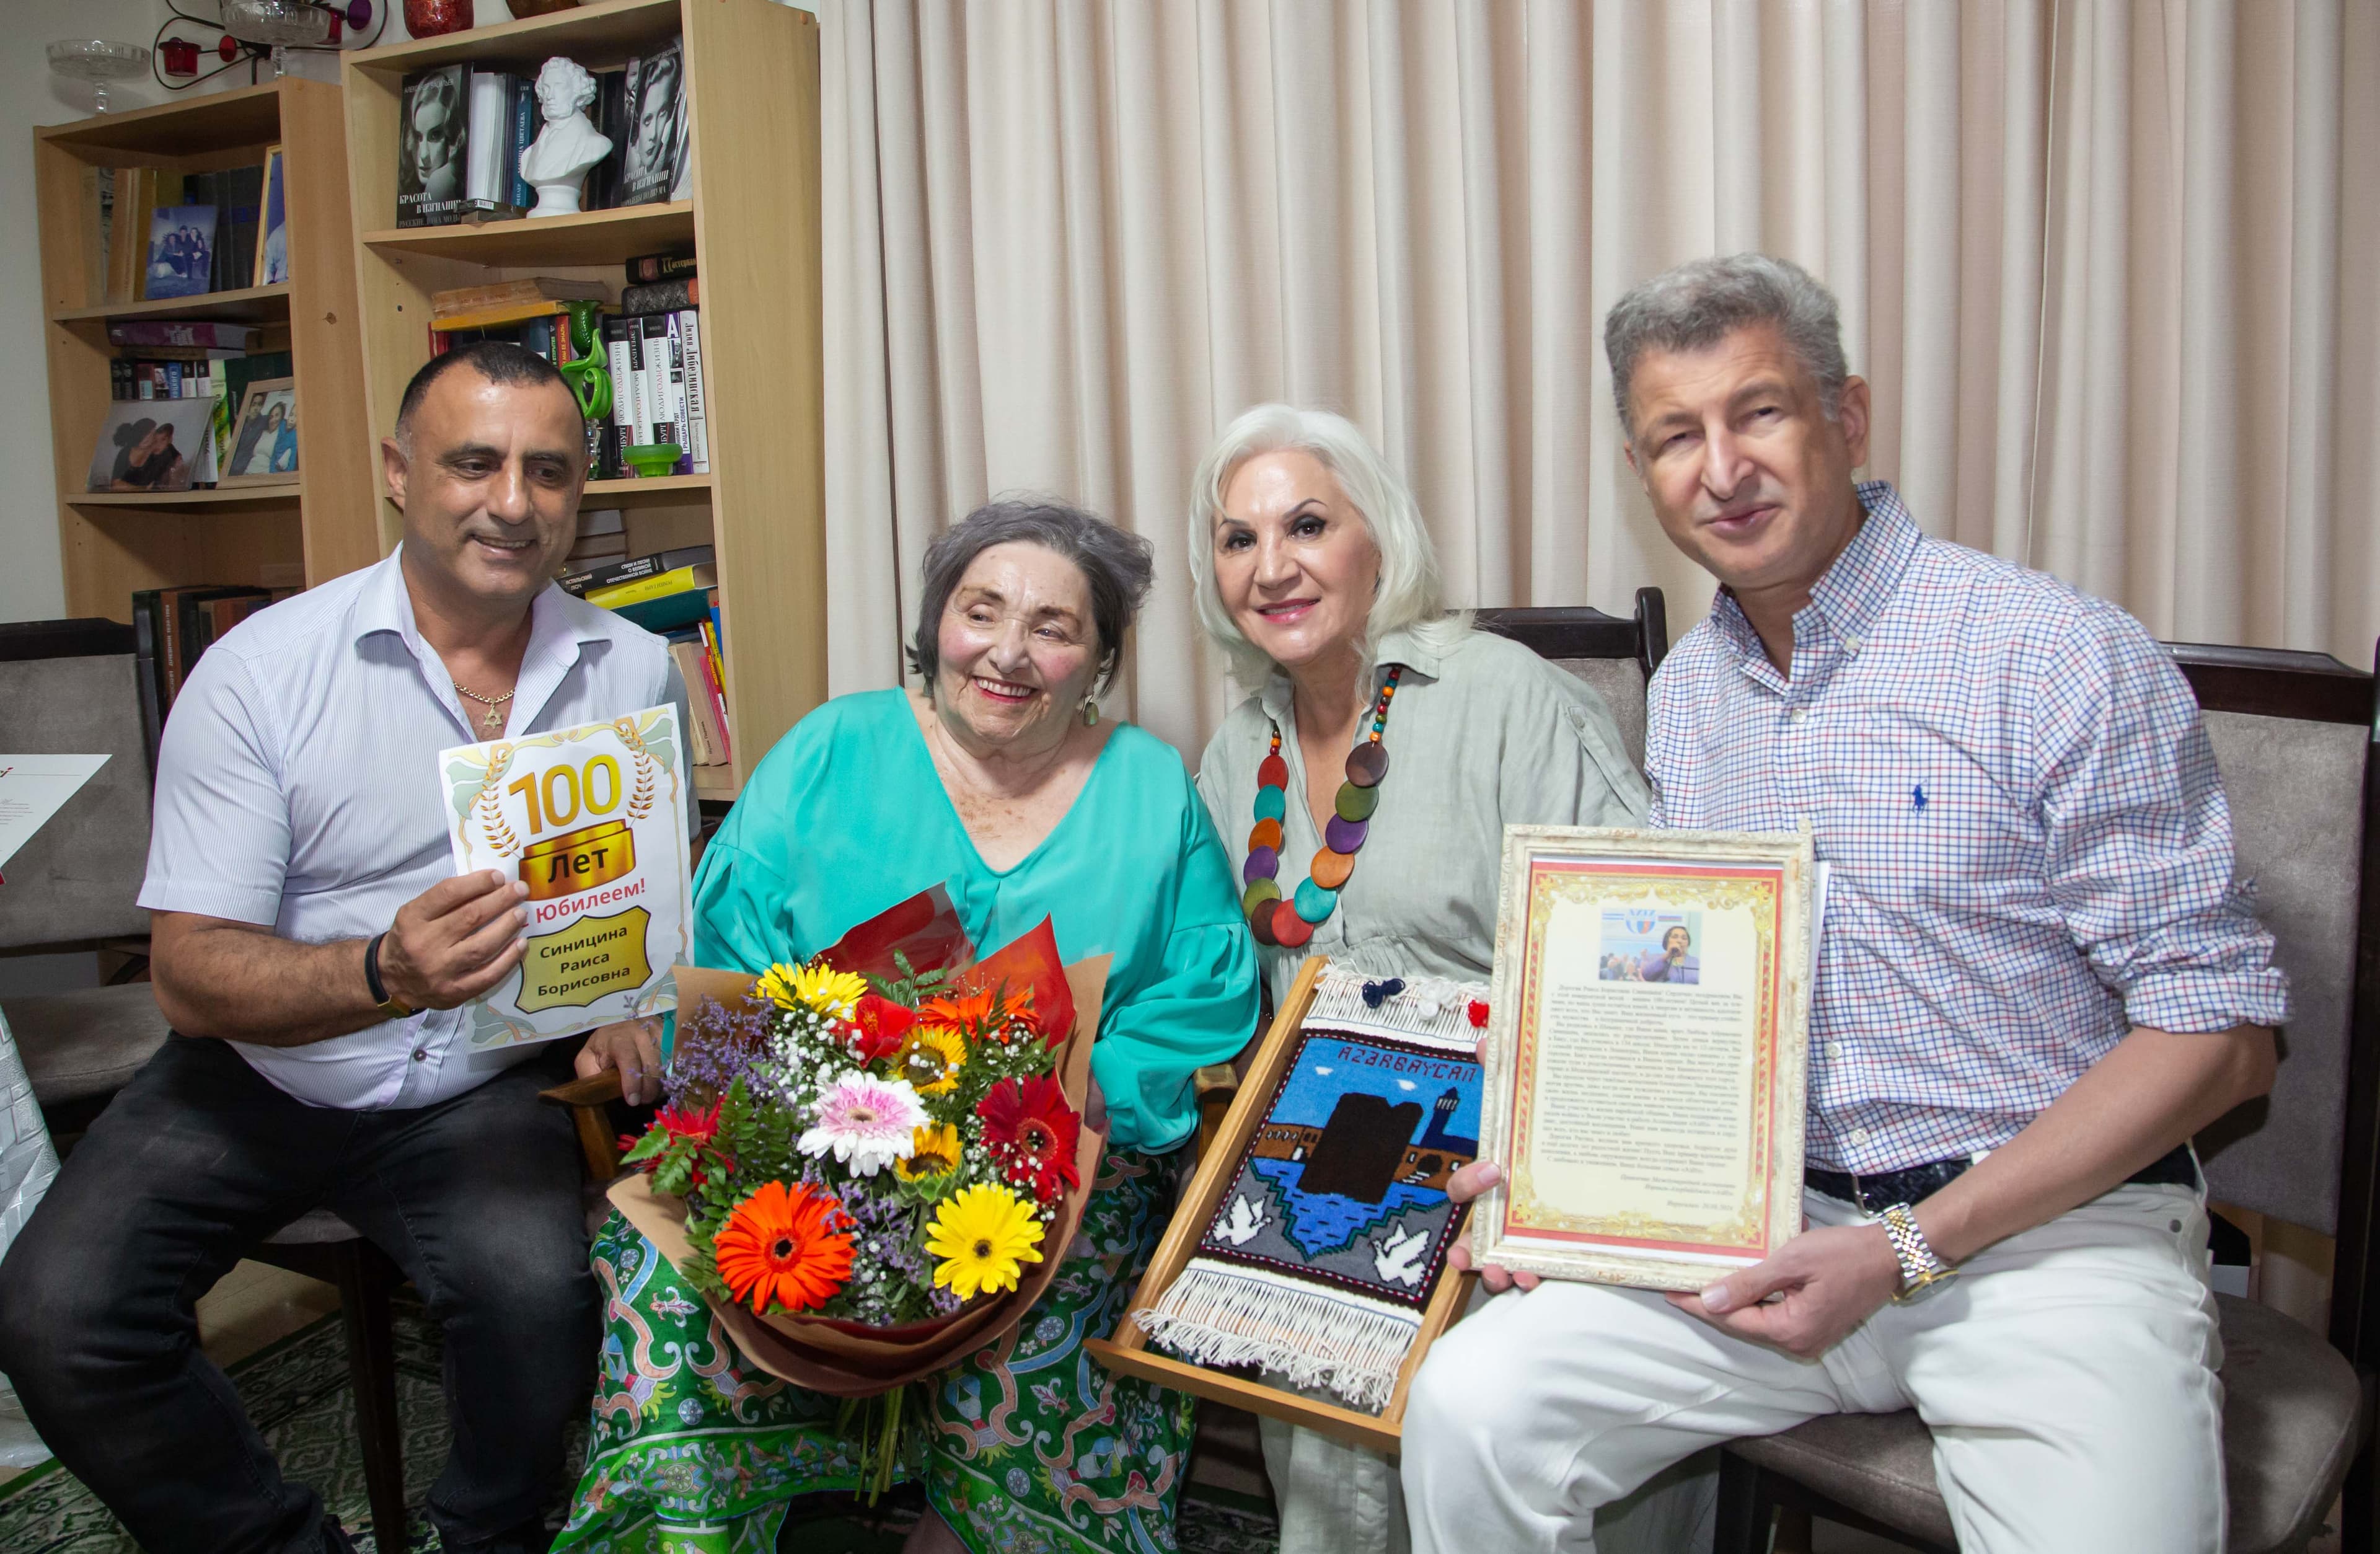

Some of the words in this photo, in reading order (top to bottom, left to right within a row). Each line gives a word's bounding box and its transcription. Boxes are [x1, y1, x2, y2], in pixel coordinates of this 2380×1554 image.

[624, 166, 647, 184] КРАСОТА
[632, 182, 637, 192] В
[637, 169, 669, 190] ИЗГНАНИИ
[399, 192, 432, 205] КРАСОТА
[416, 205, 421, 214] В
[685, 323, 695, 346] Лидия
[685, 348, 699, 412] Либединская
[659, 423, 668, 444] БУРГ
[606, 572, 639, 583] ОТЕЧЕСТВЕННОЙ
[632, 563, 651, 572] ВЕЛИКОЙ
[508, 754, 622, 836] 100
[547, 847, 609, 883] Лет
[536, 878, 645, 924] Юбилеем!
[540, 925, 627, 960] Синицина
[560, 952, 610, 974] Раиса
[537, 966, 630, 997] Борисовна
